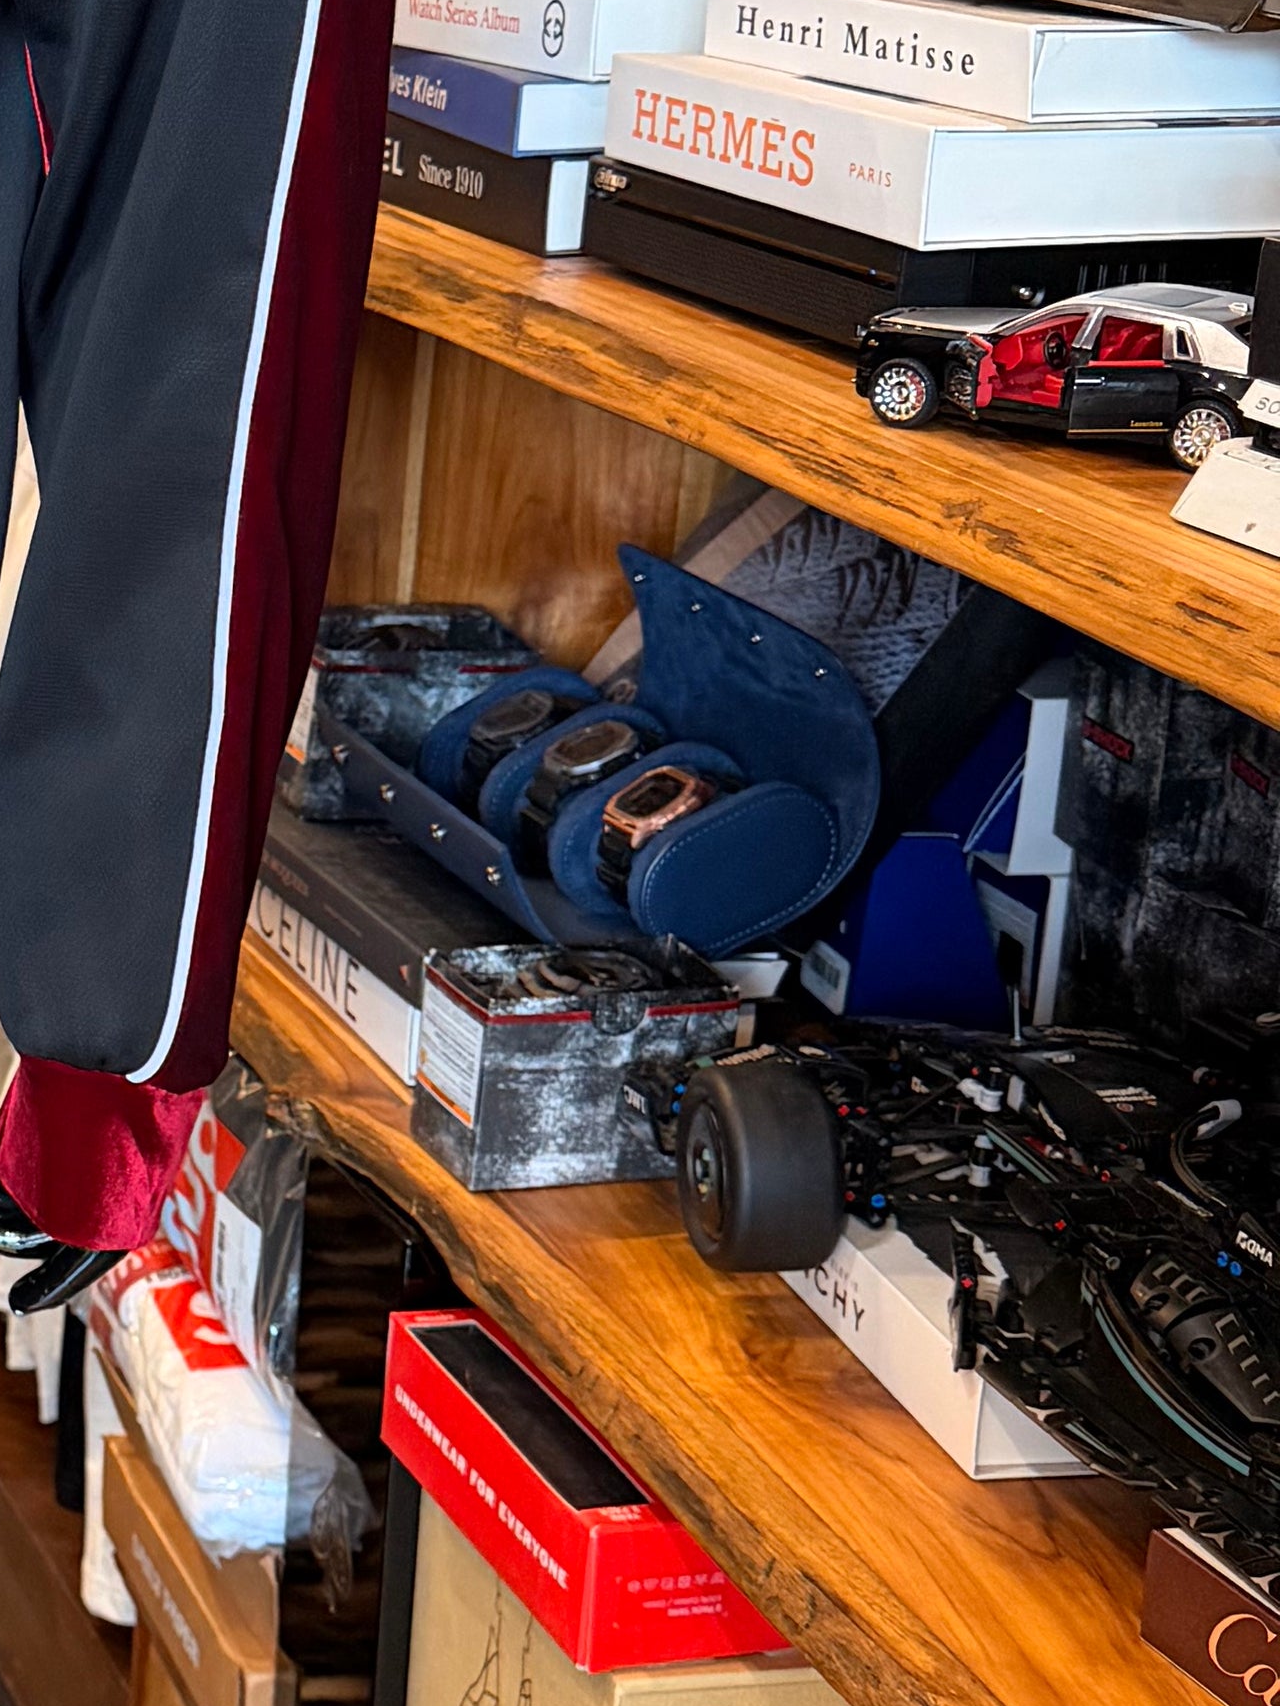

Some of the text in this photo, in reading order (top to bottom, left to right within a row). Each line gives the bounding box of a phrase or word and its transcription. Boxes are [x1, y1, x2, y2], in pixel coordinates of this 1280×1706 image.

[446, 0, 478, 27] Series
[480, 5, 521, 34] Album
[735, 4, 977, 76] Henri Matisse
[412, 73, 447, 112] Klein
[418, 153, 452, 190] Since
[454, 164, 484, 200] 1910
[849, 161, 892, 189] PARIS
[256, 883, 361, 1023] CELINE
[394, 1383, 569, 1592] UNDERWEAR FOR EVERYONE
